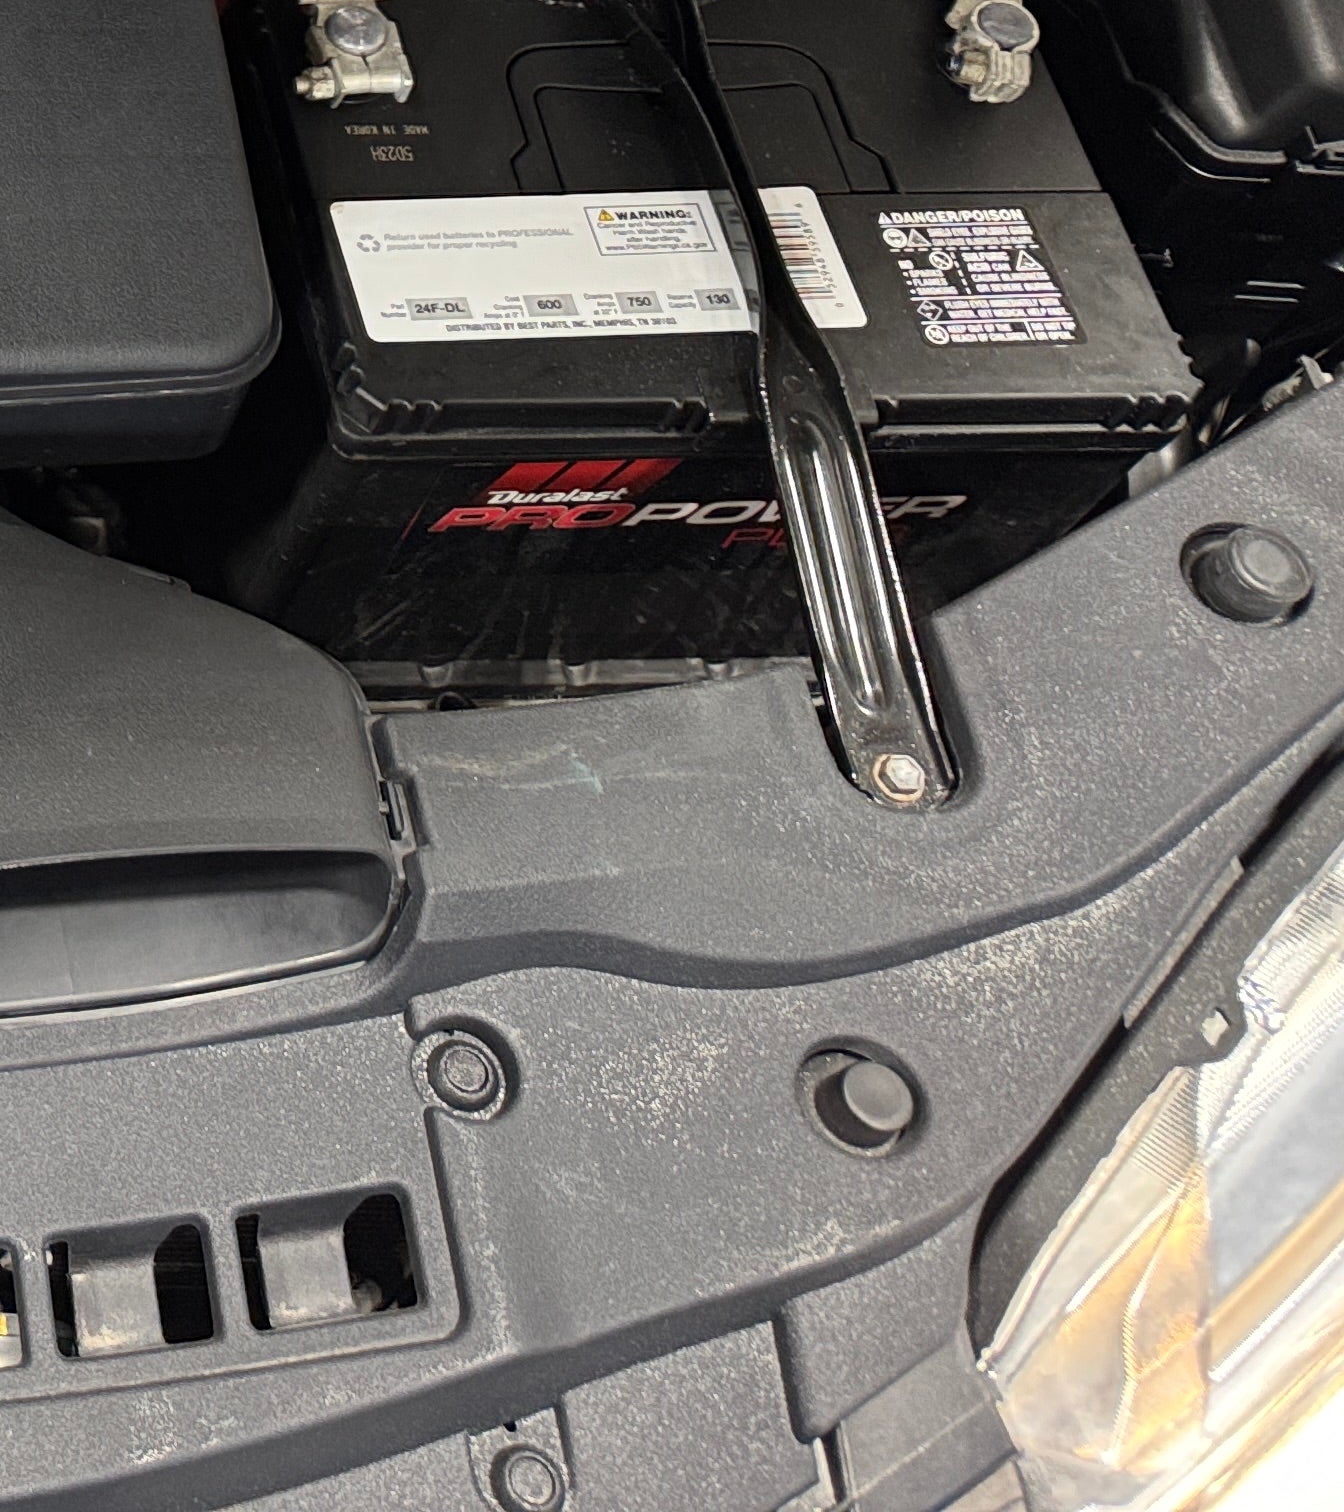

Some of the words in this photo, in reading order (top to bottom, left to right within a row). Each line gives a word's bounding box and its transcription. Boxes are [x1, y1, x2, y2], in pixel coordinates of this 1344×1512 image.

[890, 209, 1026, 224] DANGER/POISON
[537, 299, 562, 310] 600
[626, 296, 652, 307] 750
[705, 294, 731, 305] 130
[414, 302, 466, 314] 24F-DL
[446, 322, 502, 332] DISTRIBUTED
[487, 488, 629, 505] Duralast
